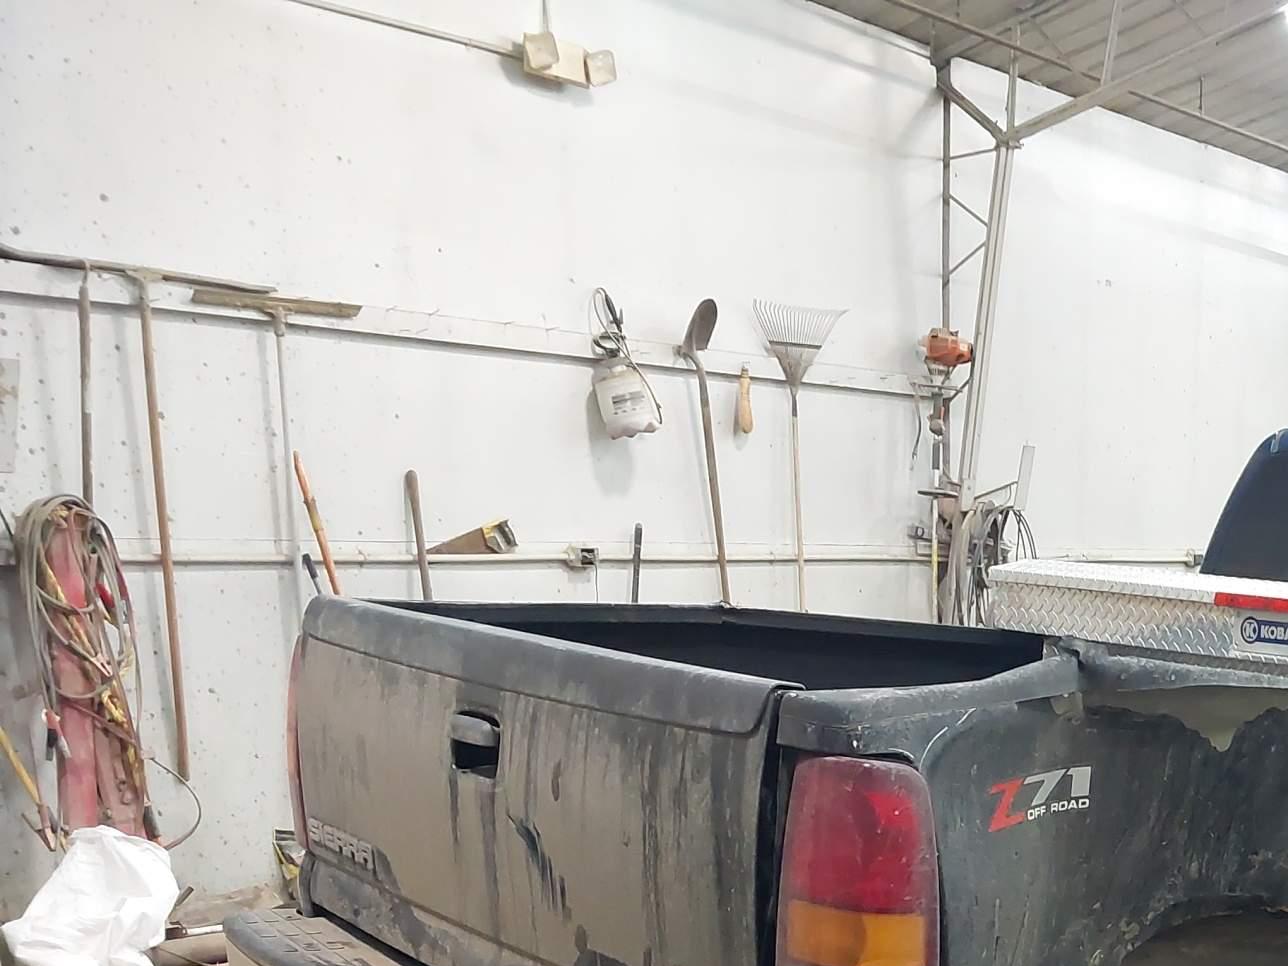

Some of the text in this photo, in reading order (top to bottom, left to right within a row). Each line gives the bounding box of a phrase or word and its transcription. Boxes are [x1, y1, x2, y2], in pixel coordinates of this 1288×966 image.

[987, 766, 1092, 833] Z71
[1027, 798, 1090, 821] OFF ROAD
[308, 817, 374, 870] SIERRA
